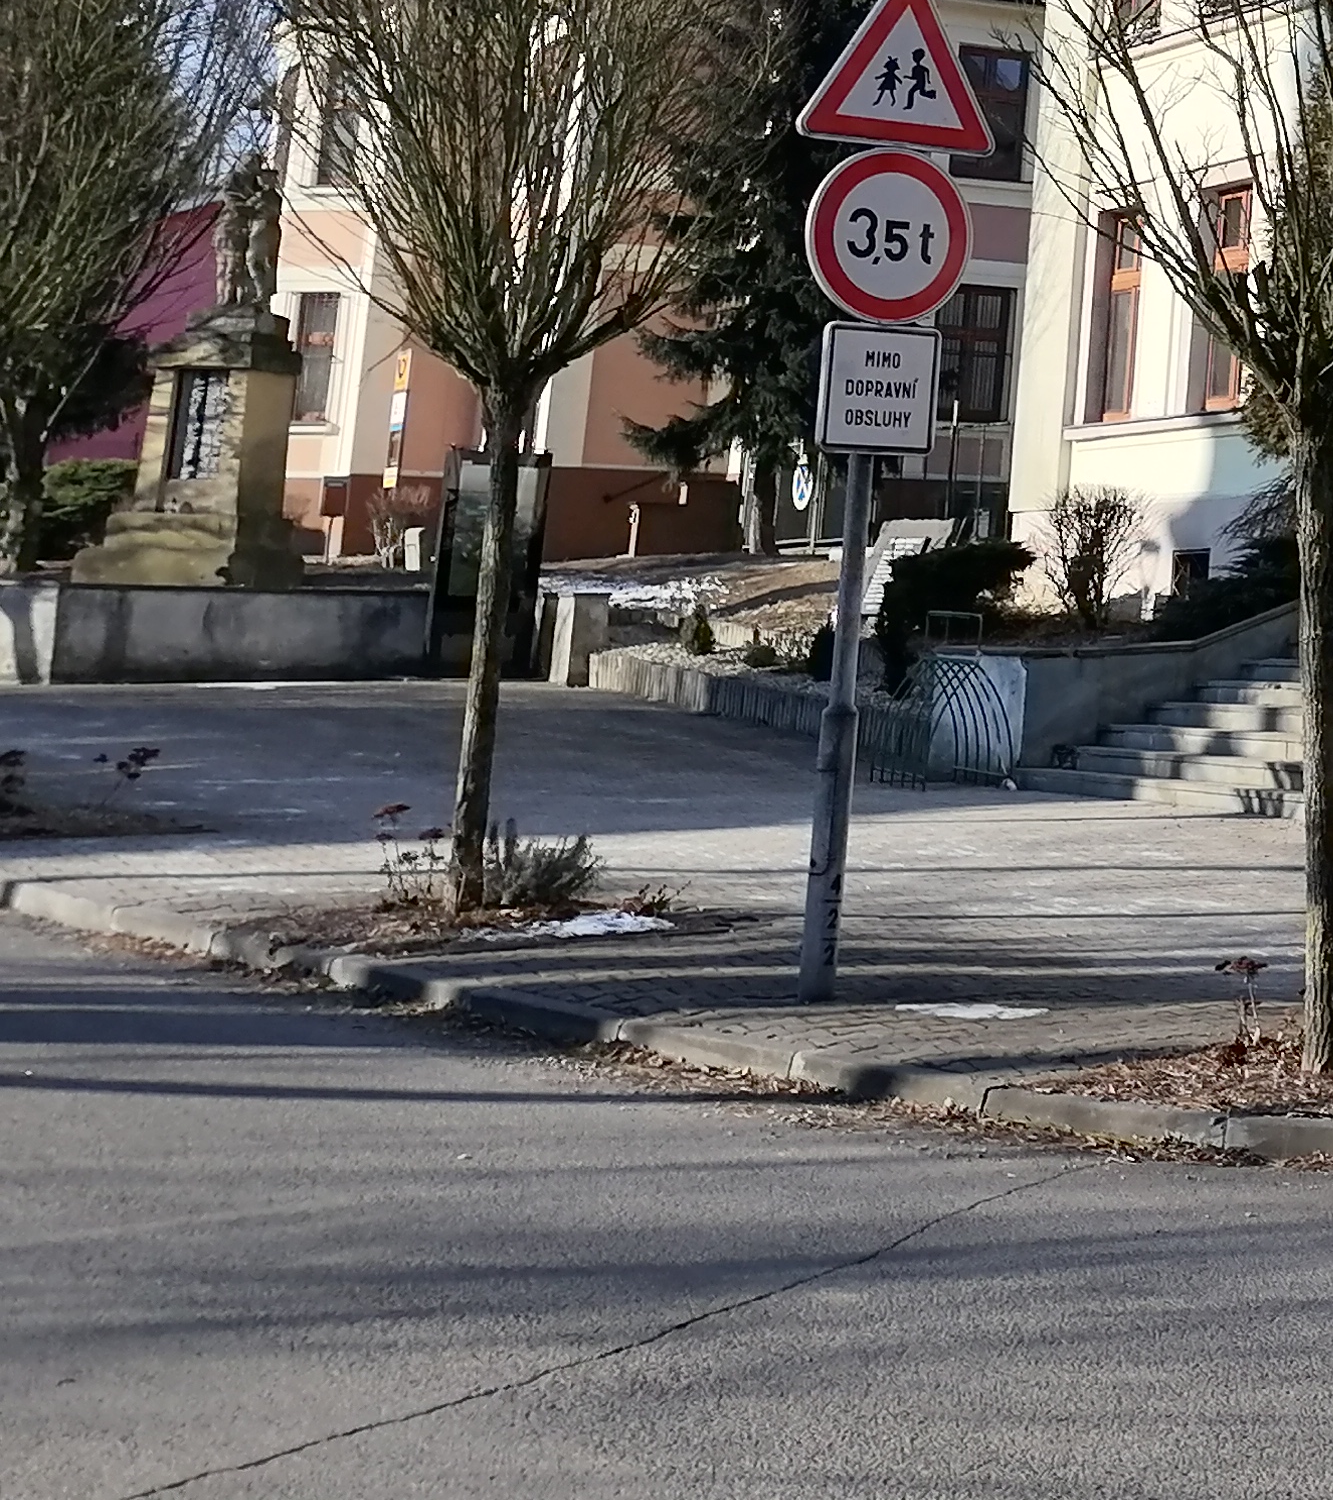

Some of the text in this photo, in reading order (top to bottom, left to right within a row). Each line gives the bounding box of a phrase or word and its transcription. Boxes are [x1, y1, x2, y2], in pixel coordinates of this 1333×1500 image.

[847, 208, 935, 265] 3,5 t
[865, 350, 901, 369] MIMO
[845, 377, 919, 399] DOPRAVNÍ
[845, 408, 912, 428] OBSLUHY
